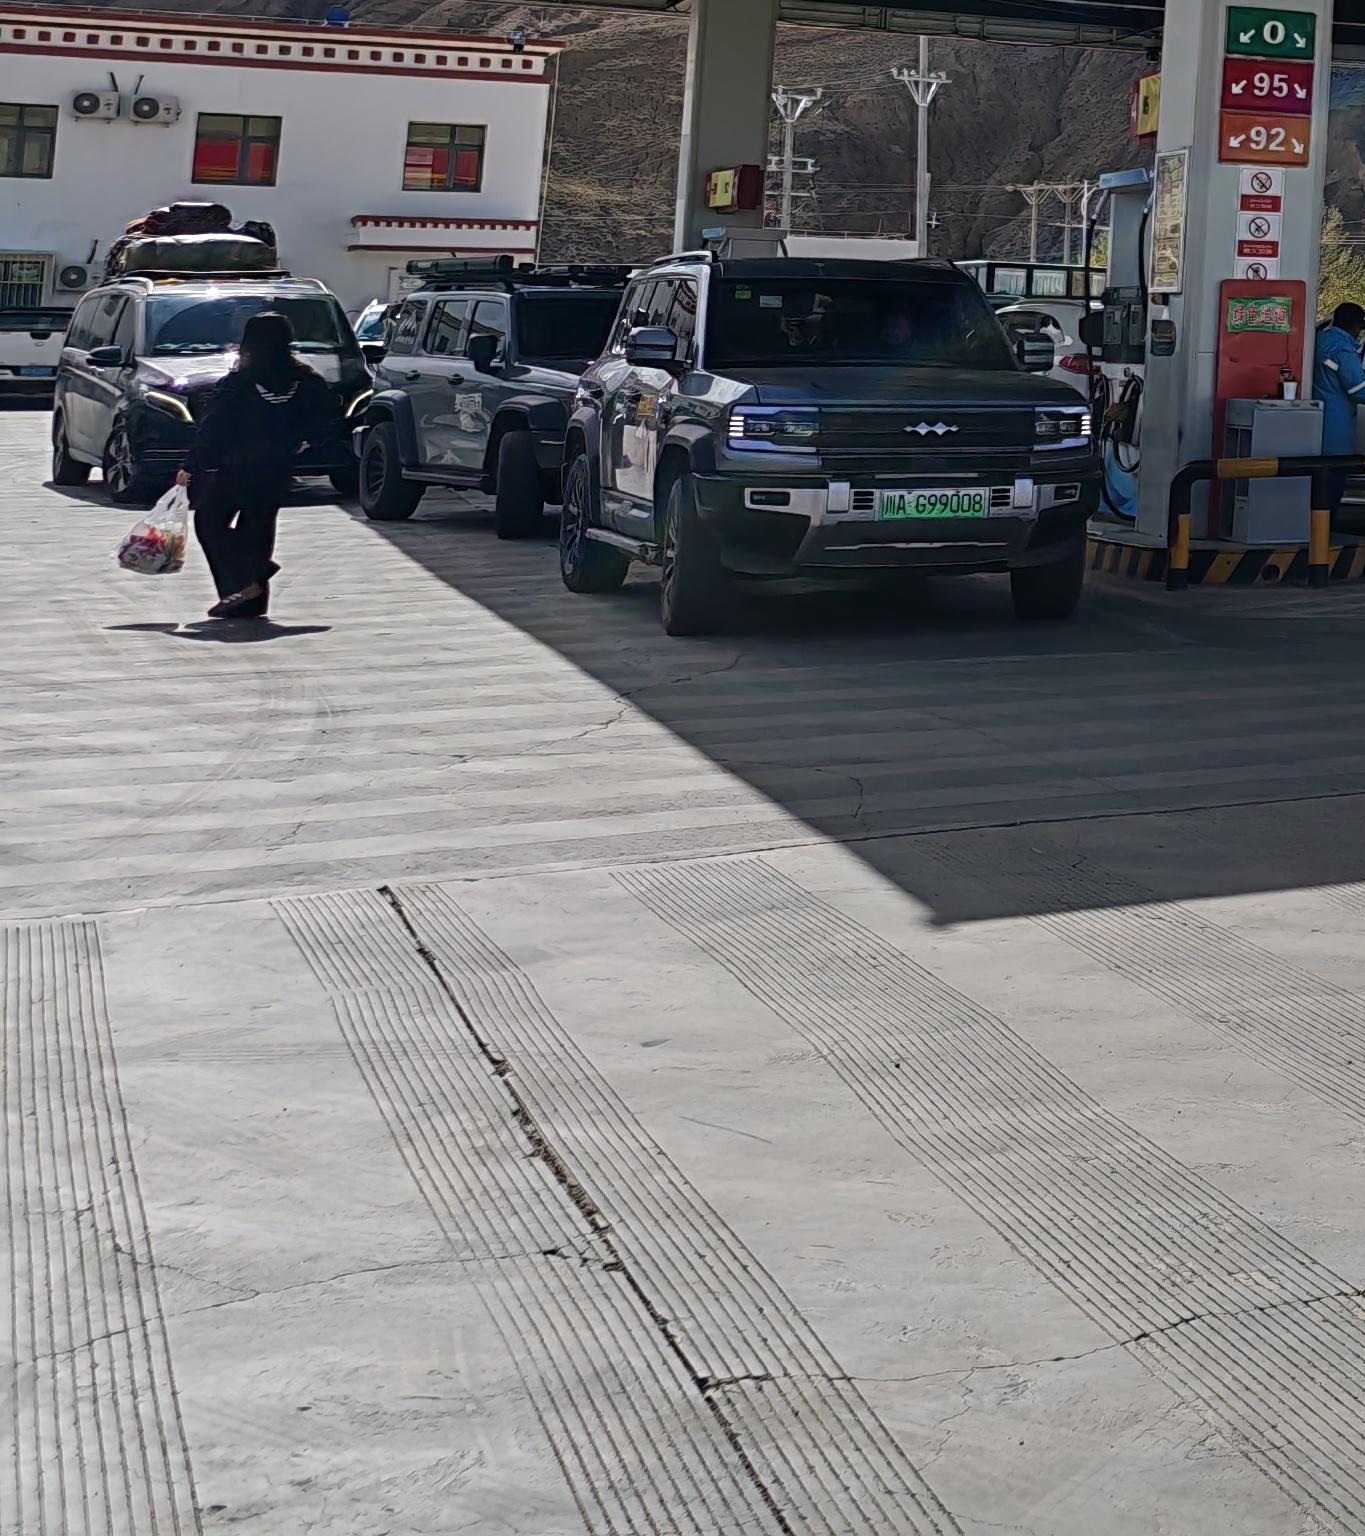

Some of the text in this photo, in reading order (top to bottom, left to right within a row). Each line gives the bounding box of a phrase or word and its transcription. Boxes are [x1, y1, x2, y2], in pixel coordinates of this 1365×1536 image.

[1263, 20, 1286, 45] 0
[1253, 72, 1289, 98] 95
[1250, 126, 1287, 151] 92
